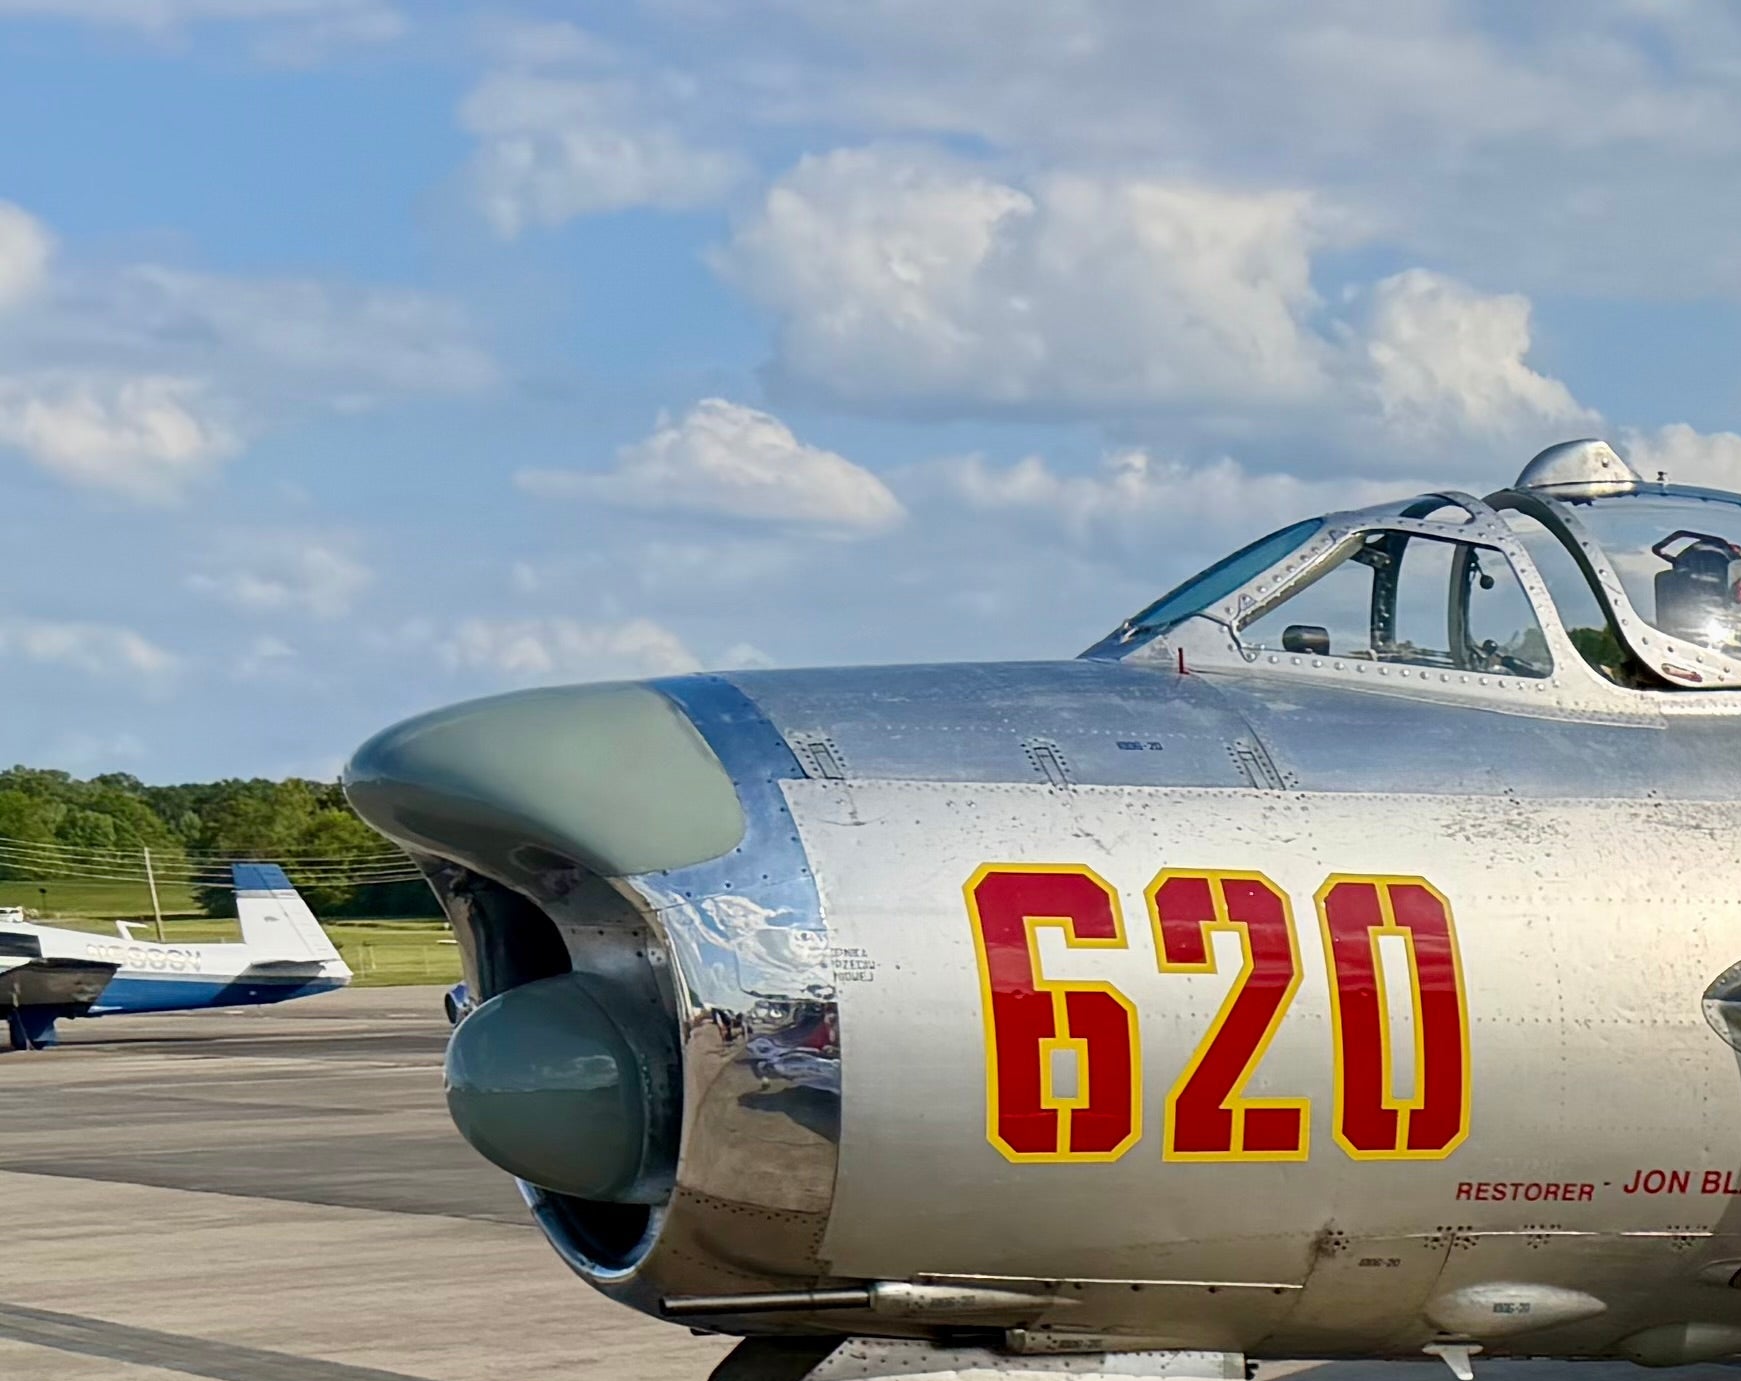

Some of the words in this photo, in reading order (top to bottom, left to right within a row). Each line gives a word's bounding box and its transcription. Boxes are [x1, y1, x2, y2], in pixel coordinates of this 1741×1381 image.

[962, 862, 1473, 1164] 620
[1456, 1181, 1594, 1202] RESTORER
[1622, 1170, 1690, 1196] JON
